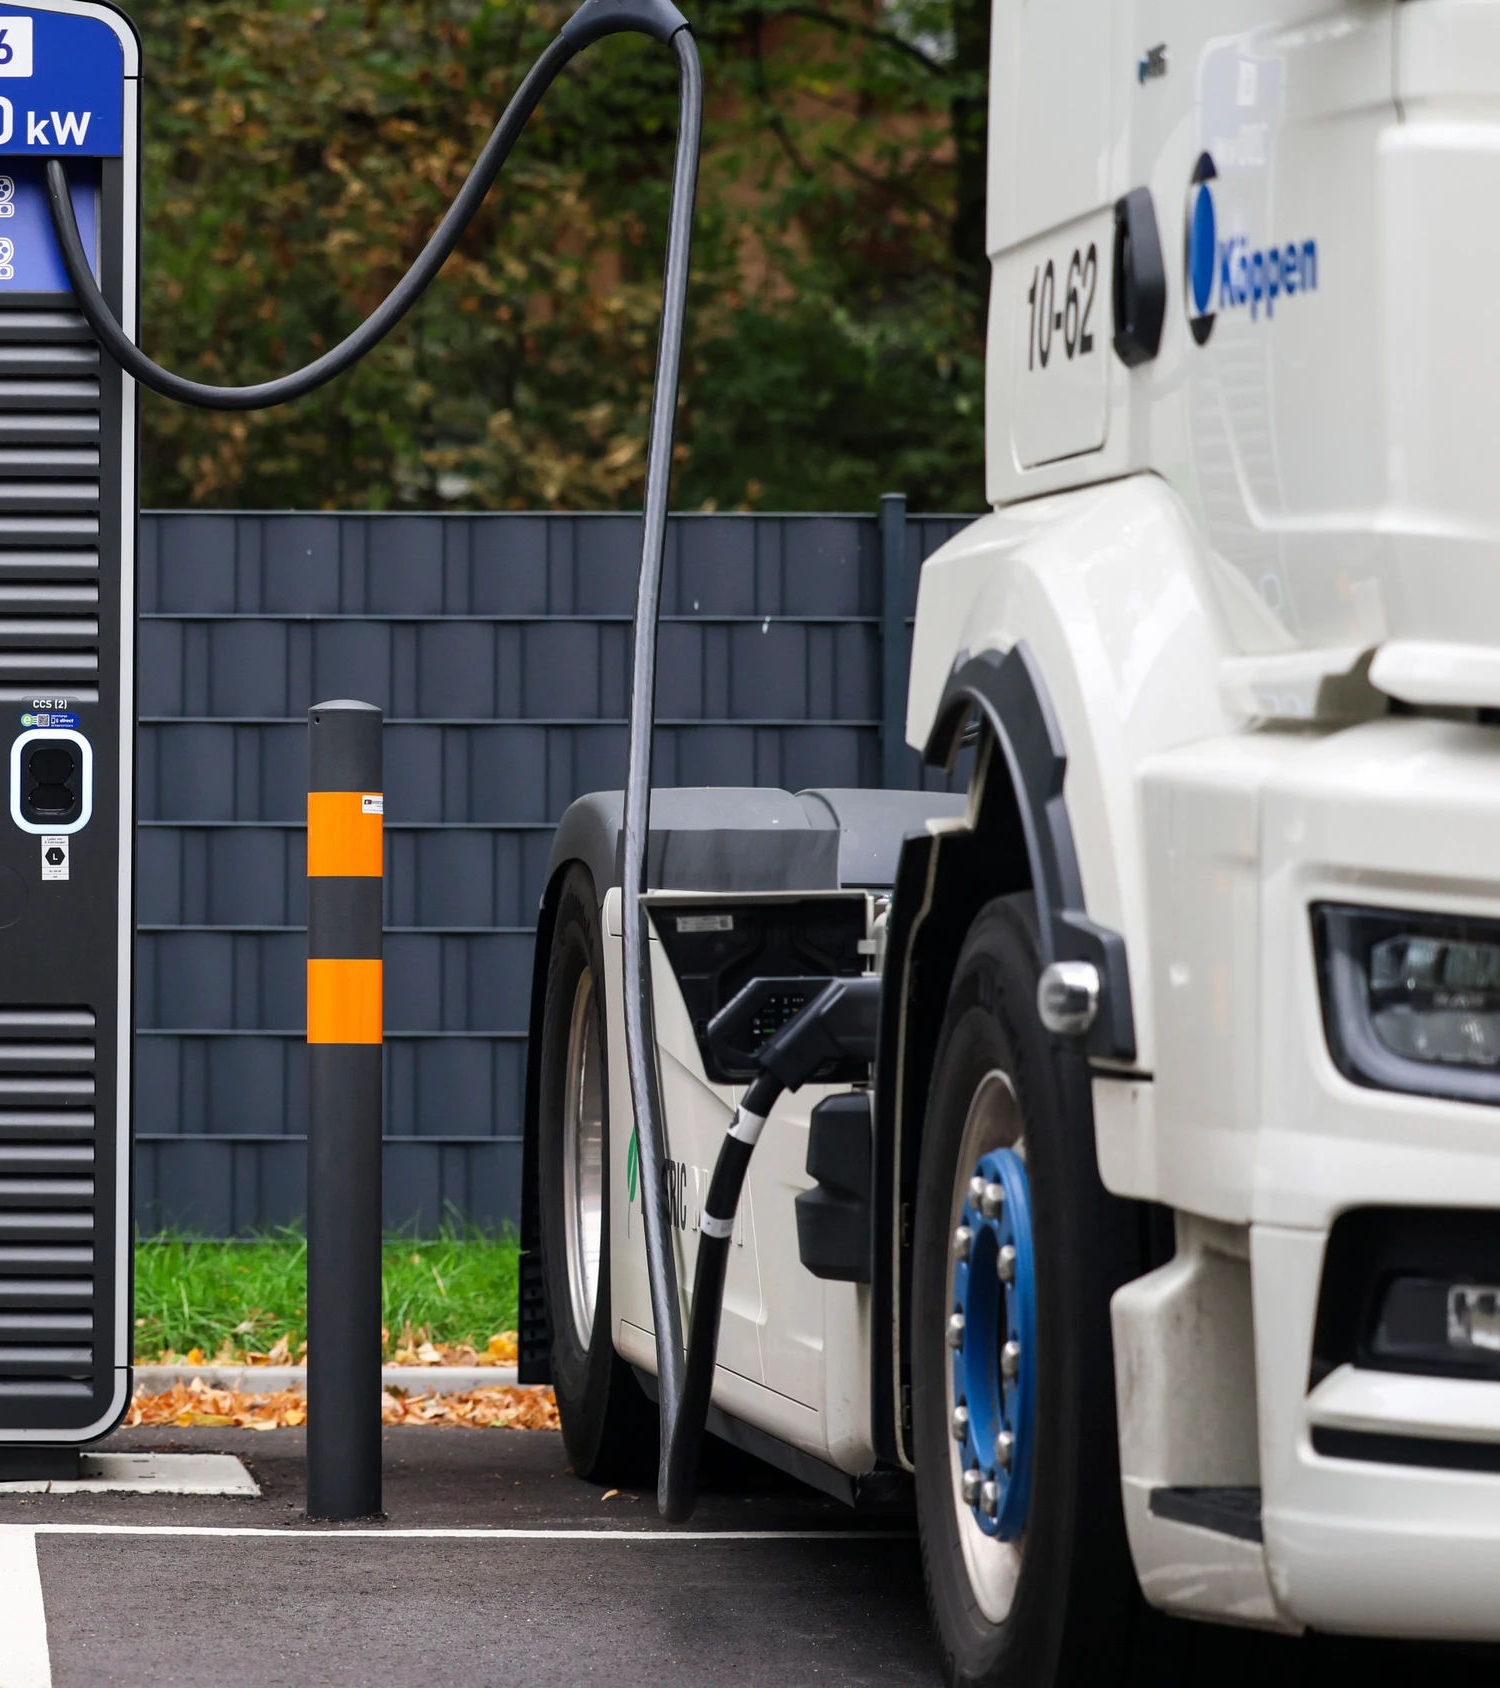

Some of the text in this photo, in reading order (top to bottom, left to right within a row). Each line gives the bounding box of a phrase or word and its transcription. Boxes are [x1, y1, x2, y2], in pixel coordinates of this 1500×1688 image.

[27, 111, 92, 146] kW
[1218, 236, 1318, 322] Köppen
[1028, 242, 1098, 371] 10-62
[32, 699, 52, 709] CCS
[52, 853, 59, 861] L
